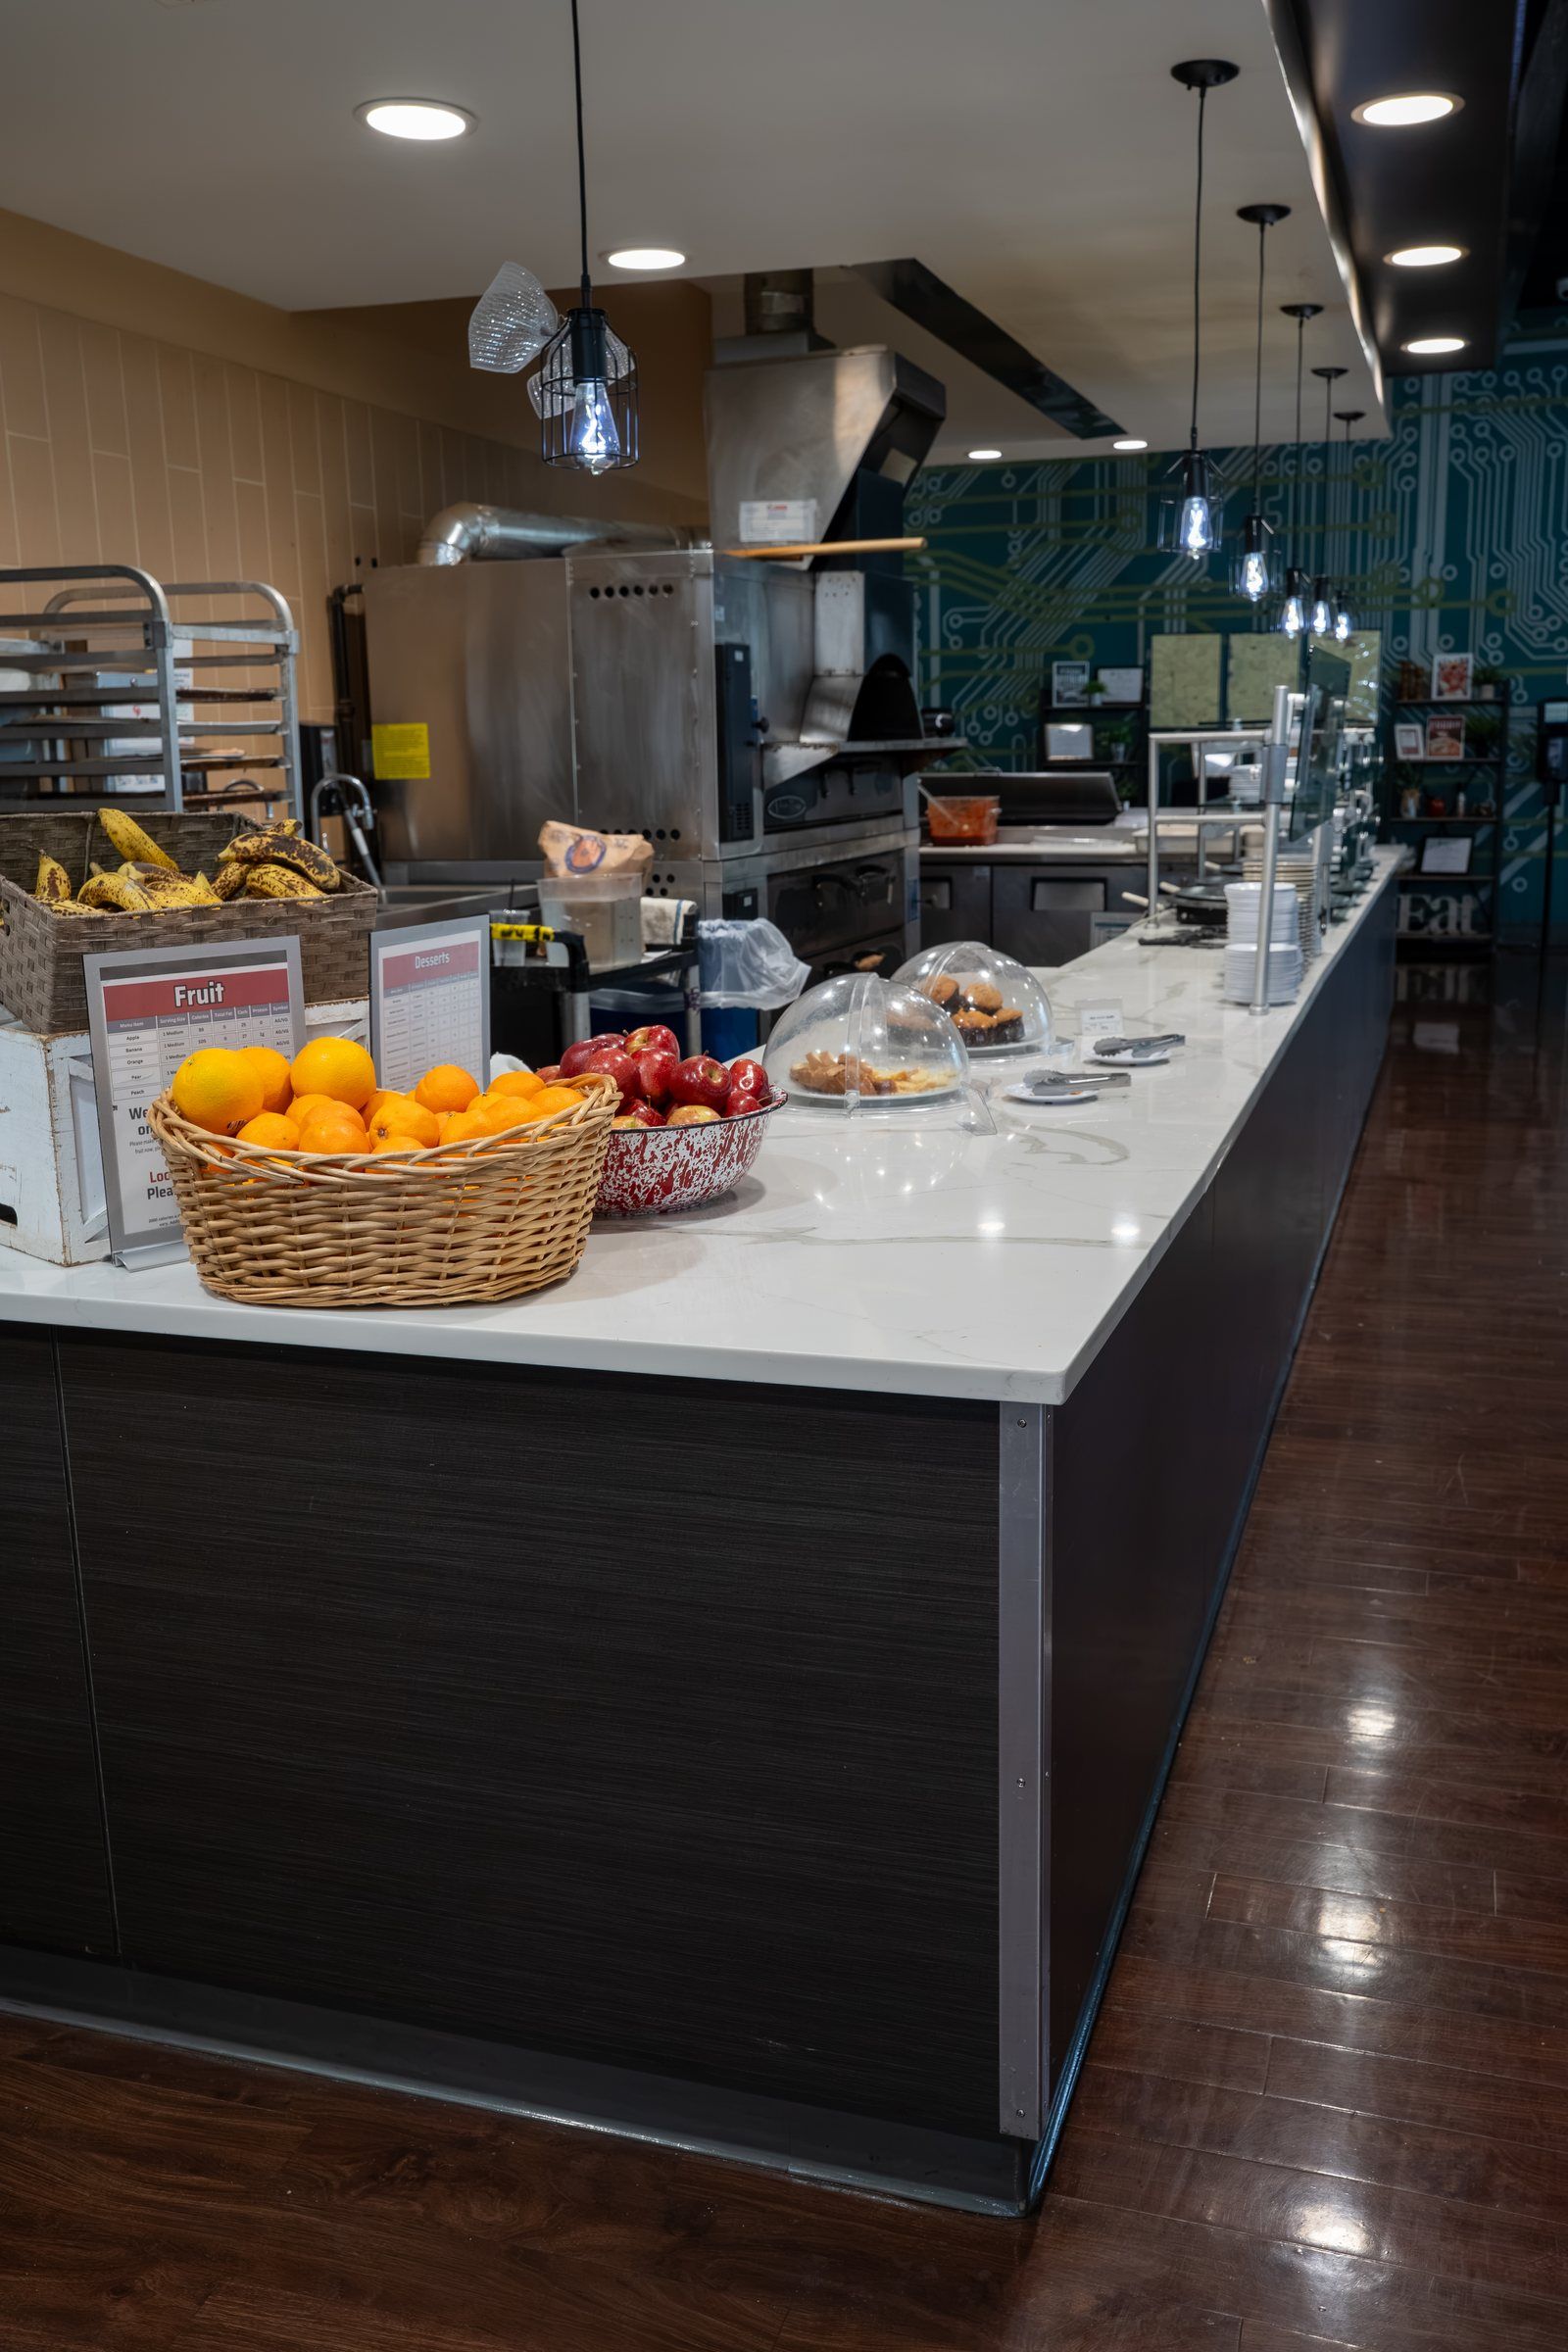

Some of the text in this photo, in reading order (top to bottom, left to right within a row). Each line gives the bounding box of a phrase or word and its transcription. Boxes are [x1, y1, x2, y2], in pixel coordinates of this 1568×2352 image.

[1396, 893, 1479, 934] Eat
[415, 952, 450, 969] Desserts
[174, 981, 224, 1007] Fruit
